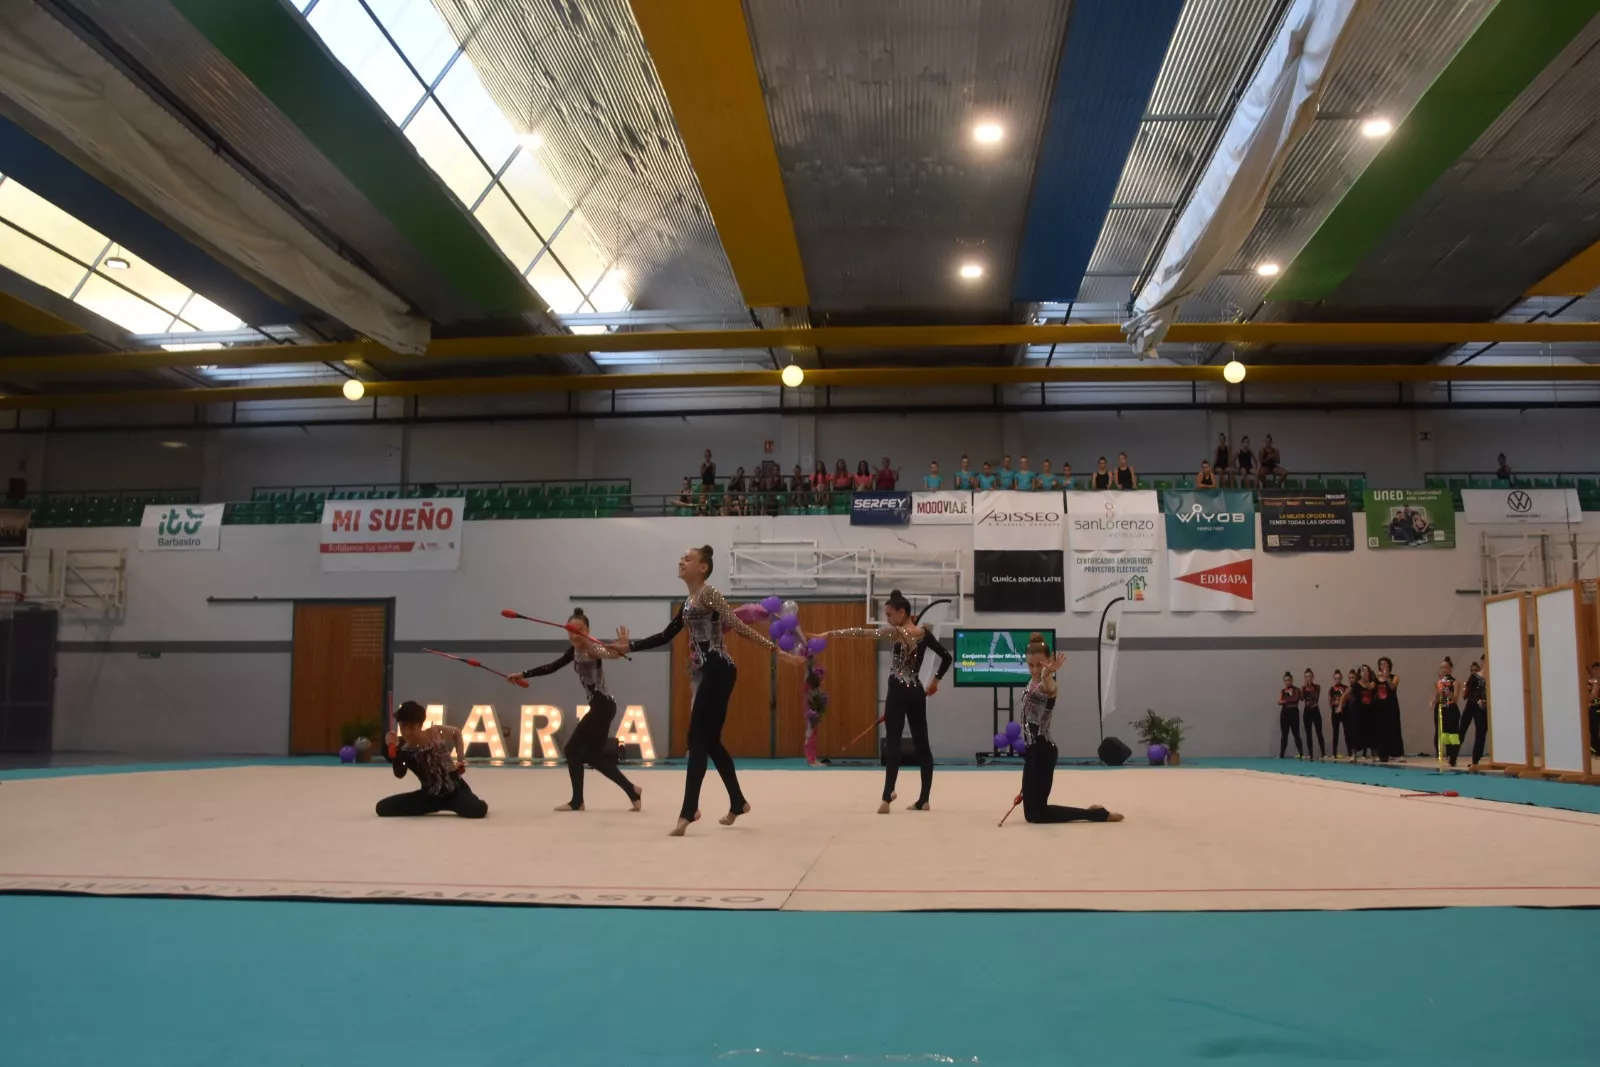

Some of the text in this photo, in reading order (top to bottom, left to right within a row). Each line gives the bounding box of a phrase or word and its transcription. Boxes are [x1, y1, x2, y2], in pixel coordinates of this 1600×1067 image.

[1374, 490, 1404, 501] UNED
[853, 498, 907, 509] SERFEY
[331, 501, 453, 532] MI SUEÑO
[157, 538, 201, 547] Barbastro
[1076, 557, 1116, 565] CERTIFICADOS
[1200, 574, 1248, 584] EDIGAPA
